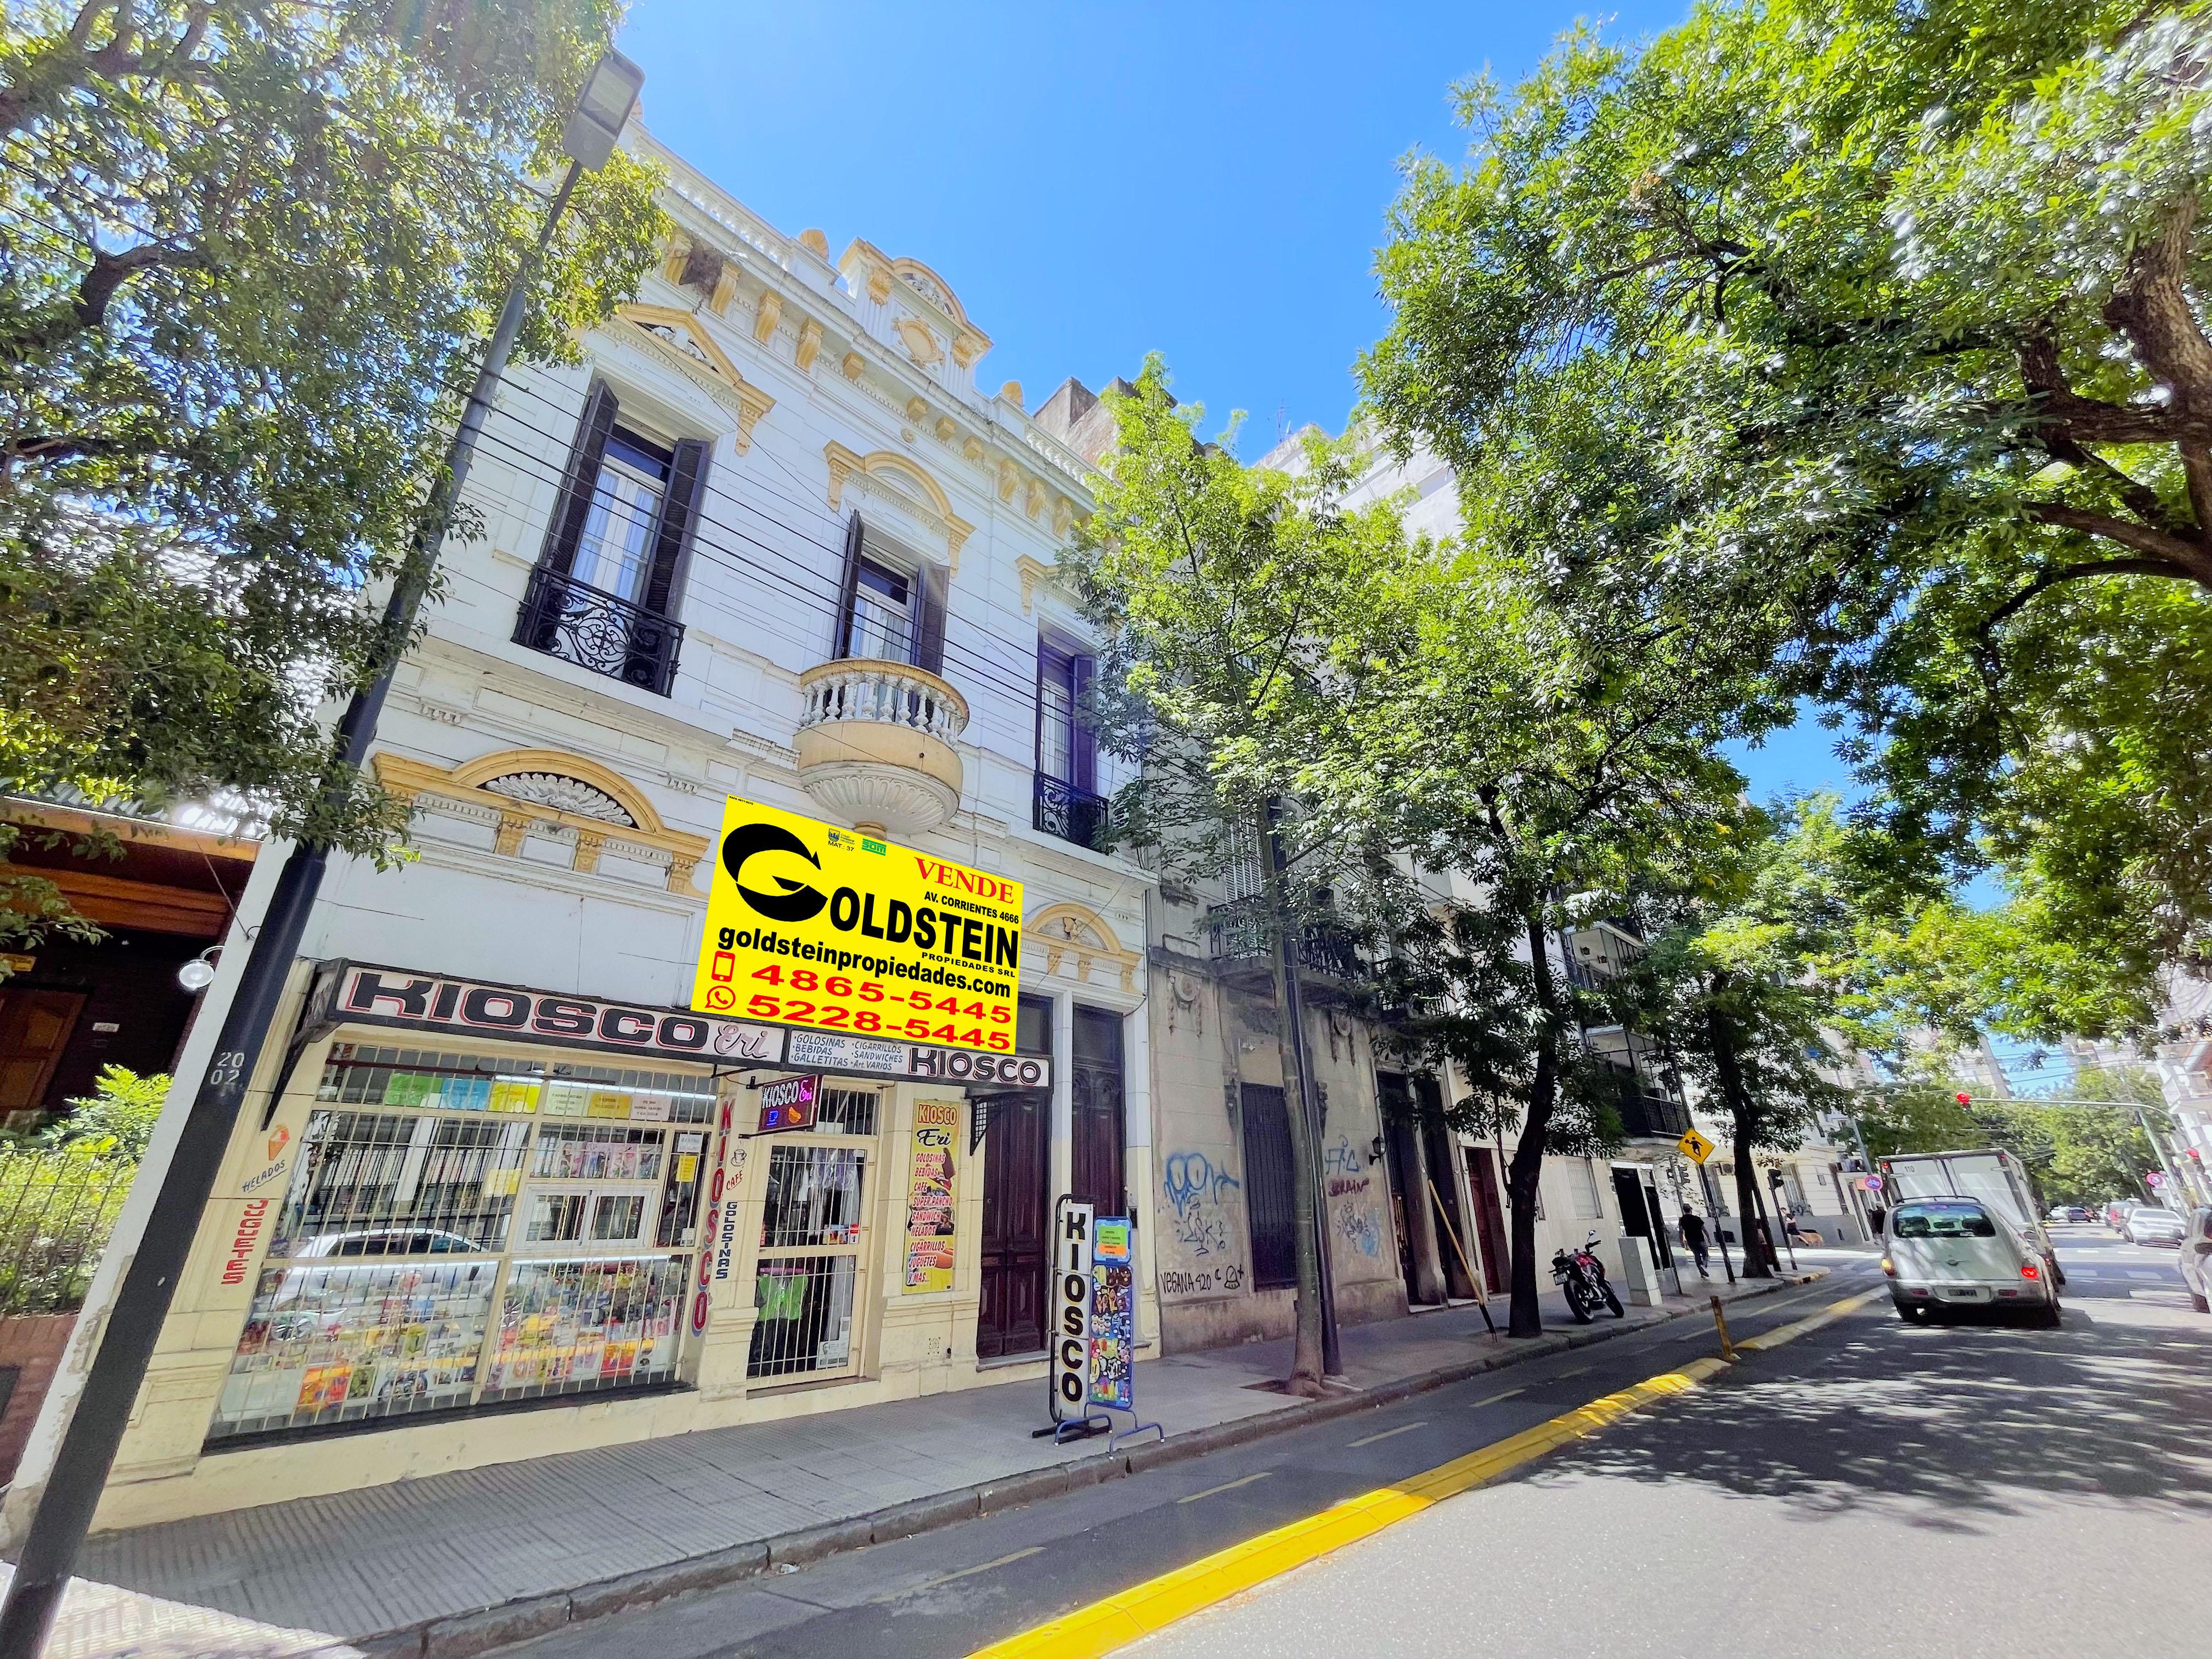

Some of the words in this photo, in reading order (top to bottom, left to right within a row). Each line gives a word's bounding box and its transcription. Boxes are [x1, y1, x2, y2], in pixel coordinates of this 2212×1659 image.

[914, 857, 1014, 904] VENDE
[924, 891, 939, 903] AV.
[941, 895, 997, 918] CORRIENTES
[999, 911, 1019, 924] 4666
[718, 927, 1011, 998] goldsteinpropiedades.com
[922, 952, 995, 973] PROPIEDADES
[997, 968, 1015, 978] SRL
[751, 964, 1011, 1024] 4865-5445
[347, 972, 709, 1051] KIOSCO
[715, 1023, 770, 1060] Eri
[747, 994, 1010, 1050] 5228-5445
[795, 1044, 833, 1056] BEBIDAS
[797, 1034, 845, 1048] GOLOSINAS
[855, 1041, 902, 1054] CIGARRILLOS
[217, 1051, 245, 1069] 20
[794, 1052, 848, 1067] GALLETITAS
[854, 1050, 904, 1063] SANDWICHES
[867, 1061, 893, 1071] VARIOS
[908, 1047, 1042, 1086] KIOSCO
[761, 1080, 799, 1109] KIOSCO
[917, 1104, 957, 1125] KIOSCO
[916, 1128, 951, 1147] Eri
[915, 1153, 946, 1163] GOLOSINAS
[241, 1159, 286, 1193] HELADOS
[915, 1166, 939, 1177] BEBIDAS
[913, 1197, 931, 1206] SUPER
[932, 1197, 953, 1206] PANCHO
[692, 1099, 735, 1336] KIOSCO
[912, 1210, 941, 1221] SANDWICH
[715, 1201, 738, 1280] GOLOSINAS
[911, 1226, 936, 1237] HELADOS
[221, 1198, 269, 1285] JUGUETES
[910, 1240, 945, 1252] CIGARRILLOS
[909, 1256, 936, 1268] JUGUETES
[908, 1273, 912, 1283] Y
[1195, 1273, 1211, 1291] 420
[1061, 1211, 1086, 1403] KIOSCO
